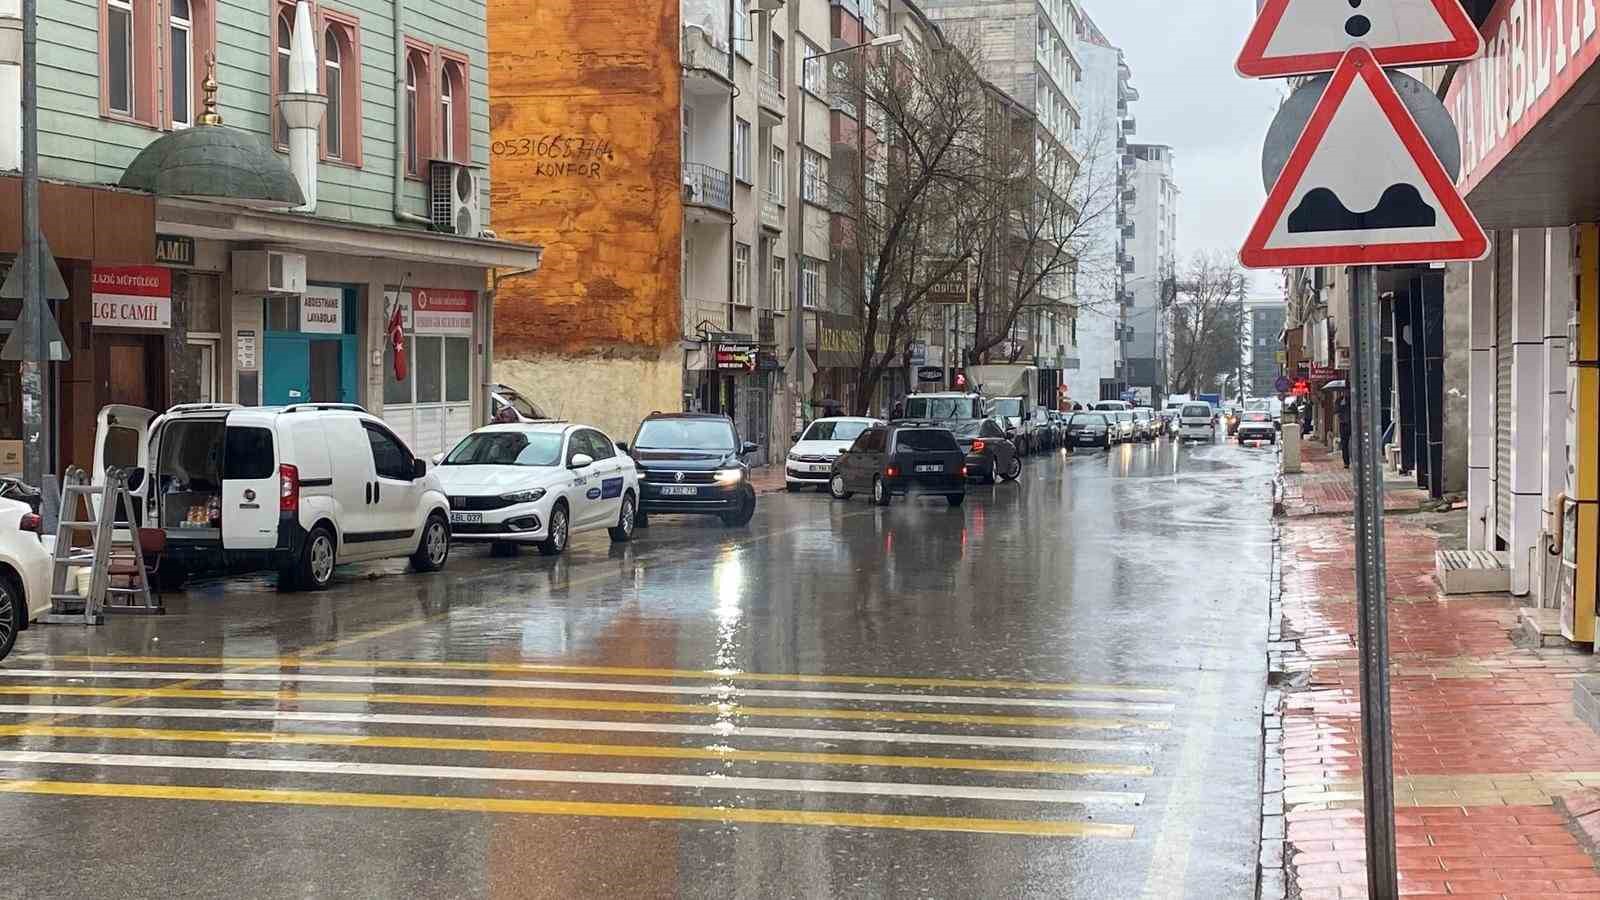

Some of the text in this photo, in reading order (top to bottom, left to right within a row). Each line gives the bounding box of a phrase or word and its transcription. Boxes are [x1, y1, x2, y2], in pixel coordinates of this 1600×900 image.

[536, 161, 601, 179] KONFOR
[156, 237, 189, 262] AMİİ
[93, 272, 115, 286] LAZIĞ
[93, 301, 117, 320] LGE
